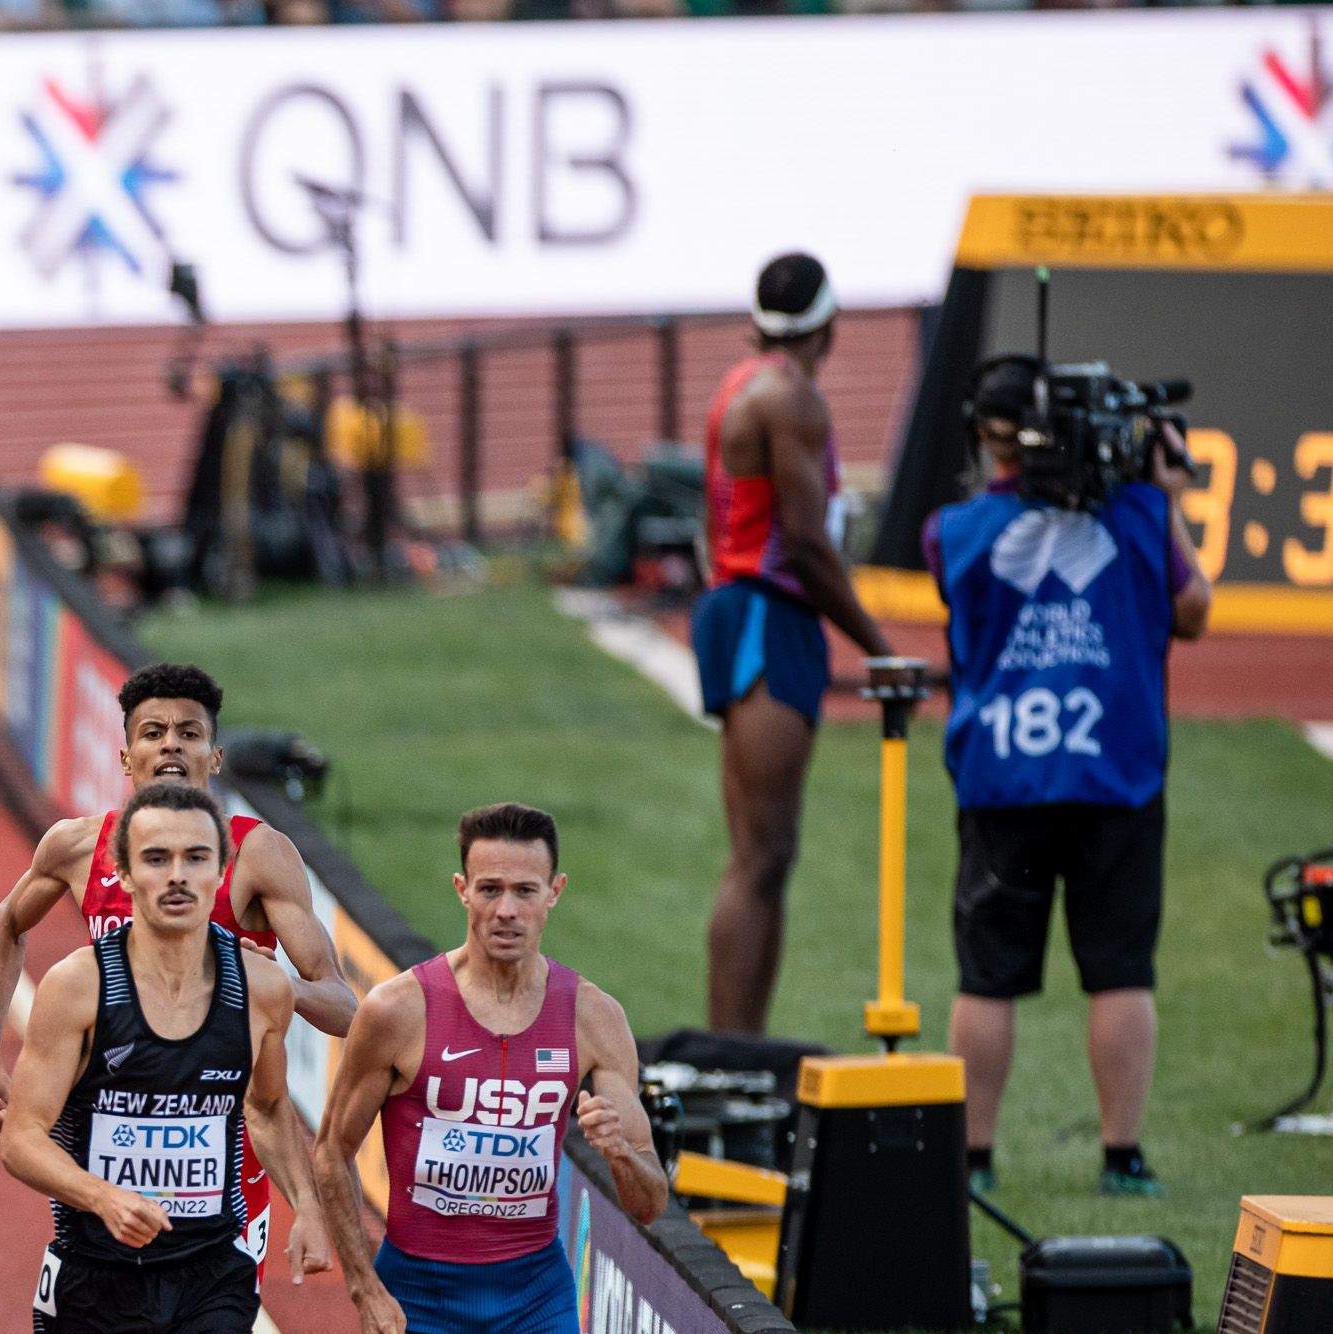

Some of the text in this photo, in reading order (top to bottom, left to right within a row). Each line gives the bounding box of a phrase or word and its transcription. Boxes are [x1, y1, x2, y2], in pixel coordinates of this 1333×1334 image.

[238, 80, 637, 253] QNB
[980, 687, 1104, 759] 182
[200, 1070, 241, 1080] 2XU
[98, 1089, 235, 1116] NEW ZEALAND
[426, 1076, 568, 1127] USA
[137, 1125, 210, 1148] TDK
[467, 1131, 541, 1157] TDK
[99, 1155, 217, 1187] TANNER
[425, 1160, 547, 1195] THOMPSON
[436, 1197, 527, 1217] OREGON22
